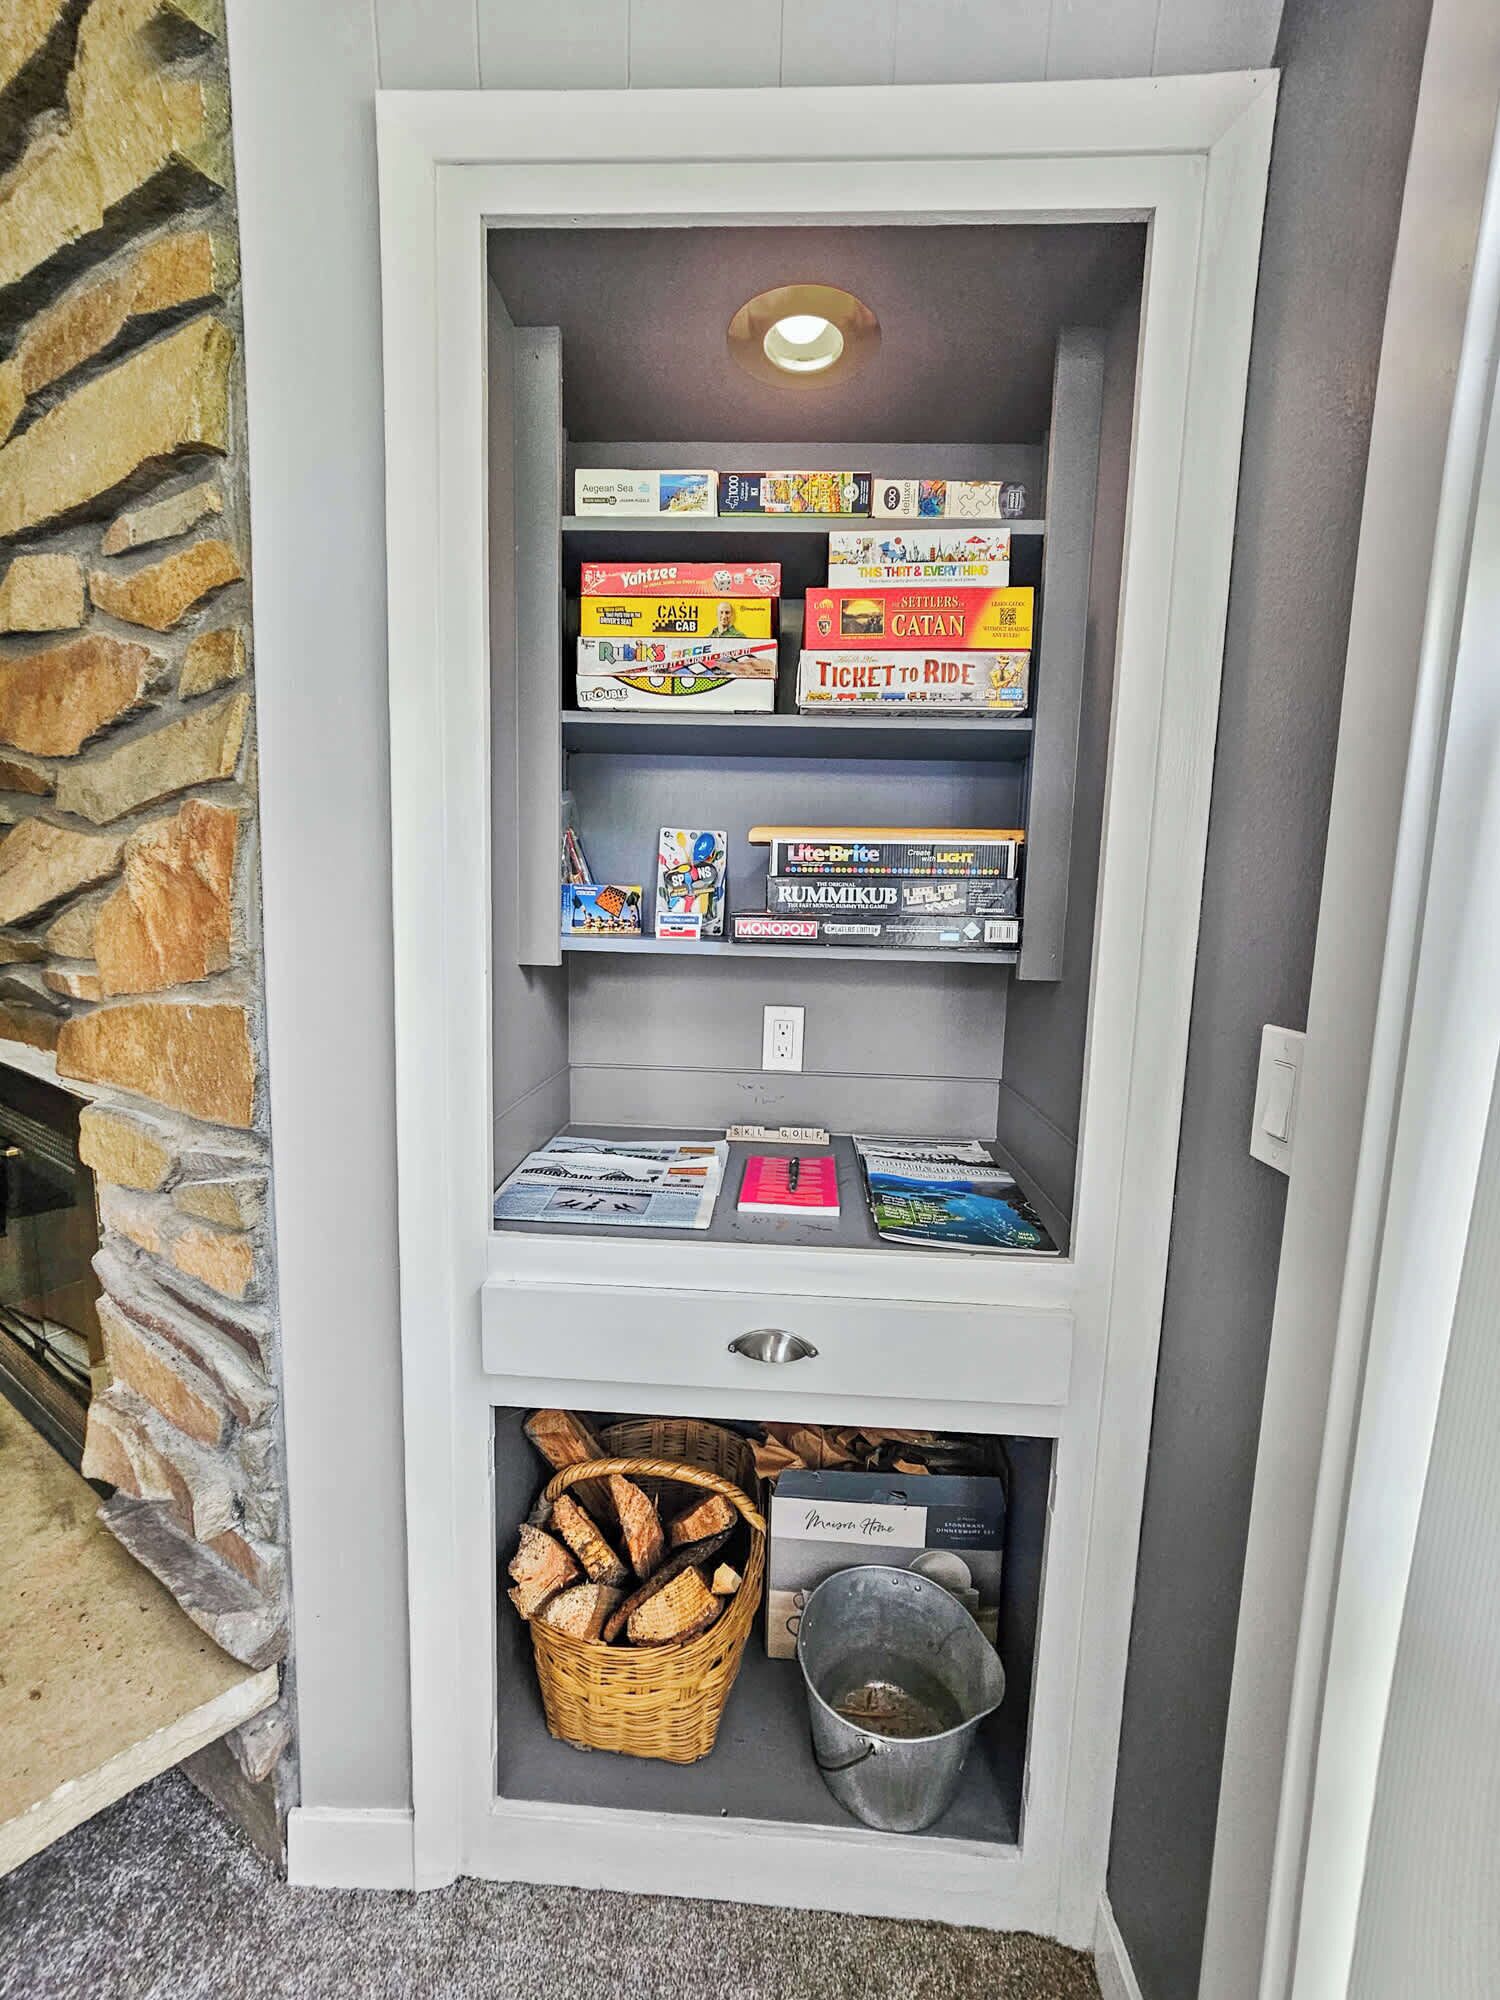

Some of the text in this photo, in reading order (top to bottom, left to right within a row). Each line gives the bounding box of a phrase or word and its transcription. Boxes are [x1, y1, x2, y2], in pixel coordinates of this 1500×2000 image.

[582, 483, 633, 494] Aegean Sea
[728, 475, 739, 495] 1000
[901, 482, 911, 515] deluxe
[621, 567, 677, 588] Yahtzee
[857, 565, 990, 578] THIS THAT & EVERYTHING
[902, 596, 959, 608] SETTLERS
[675, 620, 697, 632] CAB
[892, 614, 965, 637] CATAN
[672, 645, 712, 657] RACE
[815, 659, 976, 688] TICKET TO RIDE
[580, 686, 628, 701] TROUBLE
[936, 852, 974, 863] LIGHT
[778, 886, 898, 904] RUMMIKUB
[739, 922, 815, 936] MONOPOLY
[734, 1127, 822, 1138] SKI GOLF
[521, 1168, 592, 1180] MOUNTAIN
[805, 1509, 895, 1535] Maison Home
